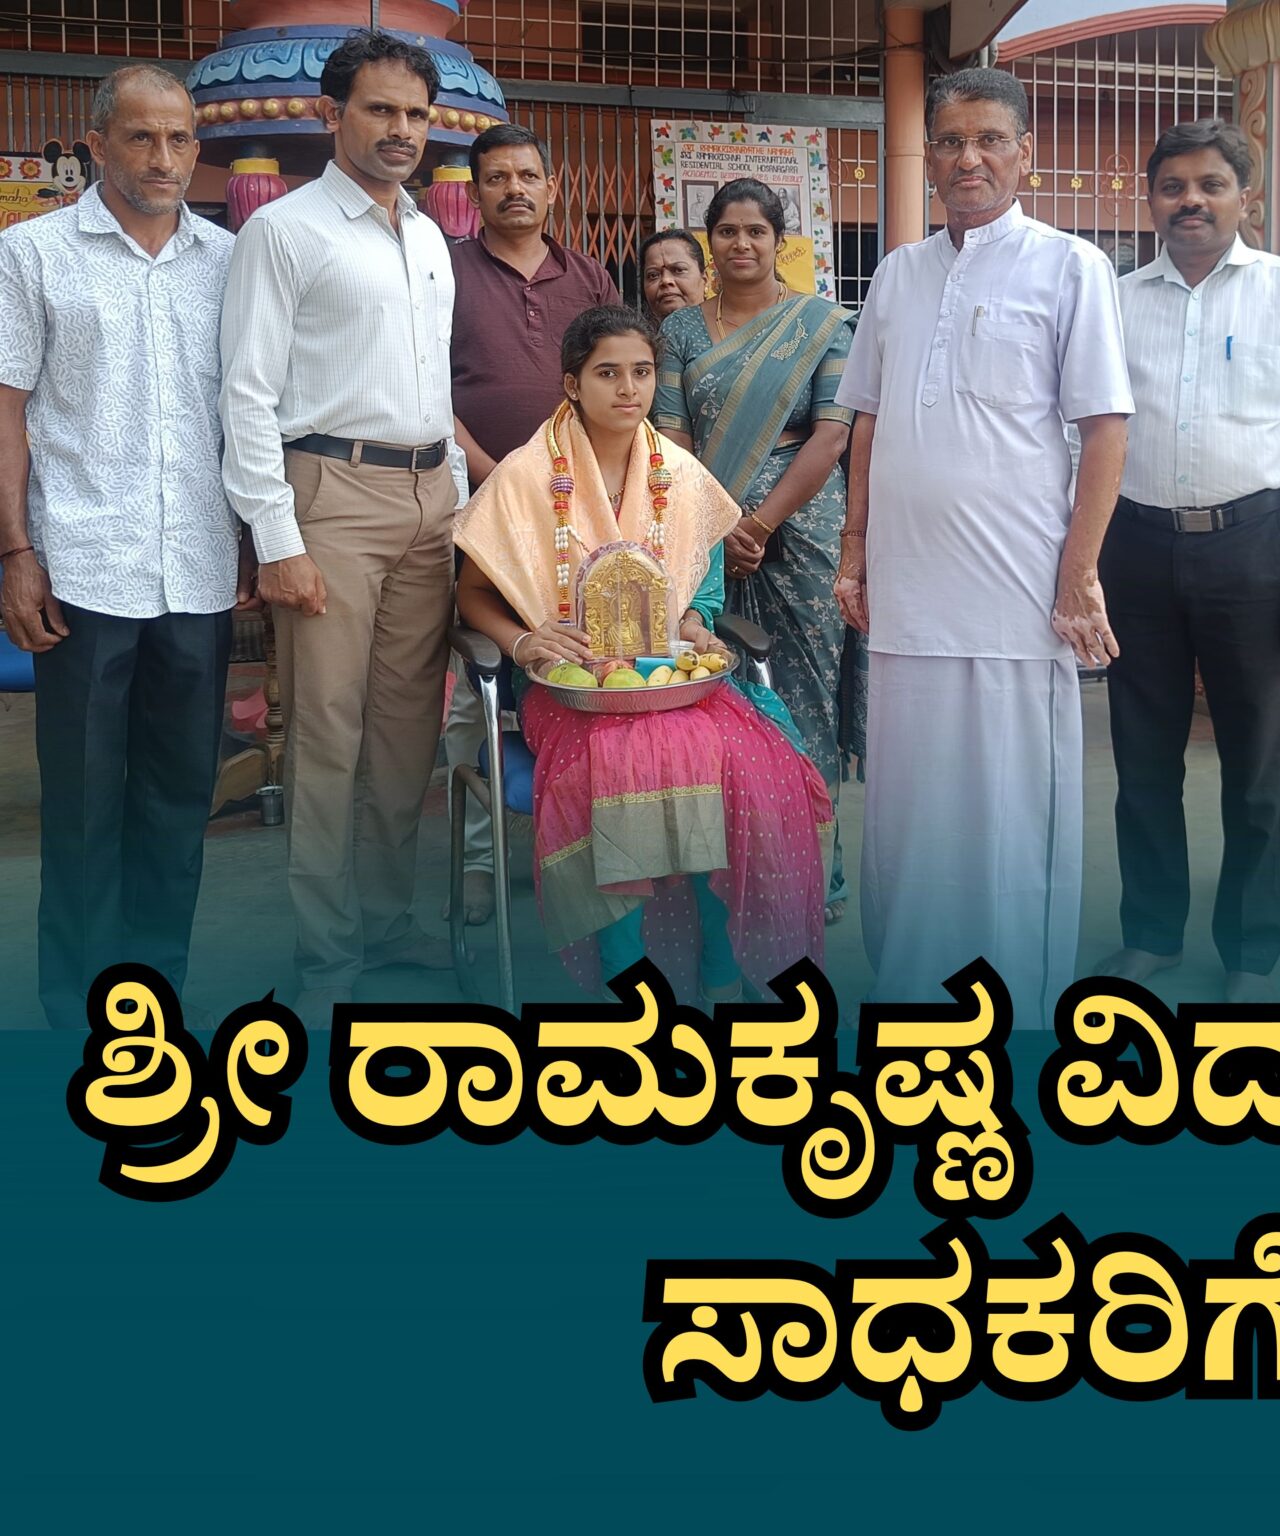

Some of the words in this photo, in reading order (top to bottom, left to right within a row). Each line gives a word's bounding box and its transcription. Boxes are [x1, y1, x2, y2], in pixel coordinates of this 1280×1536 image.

[680, 151, 693, 160] SRI
[696, 152, 742, 163] RAMAKRISHNA
[745, 154, 799, 165] INTERNATIONAL
[680, 160, 724, 171] RESIDENTIAL
[727, 162, 753, 172] SCHOOL
[682, 169, 718, 180] ACADEMIC
